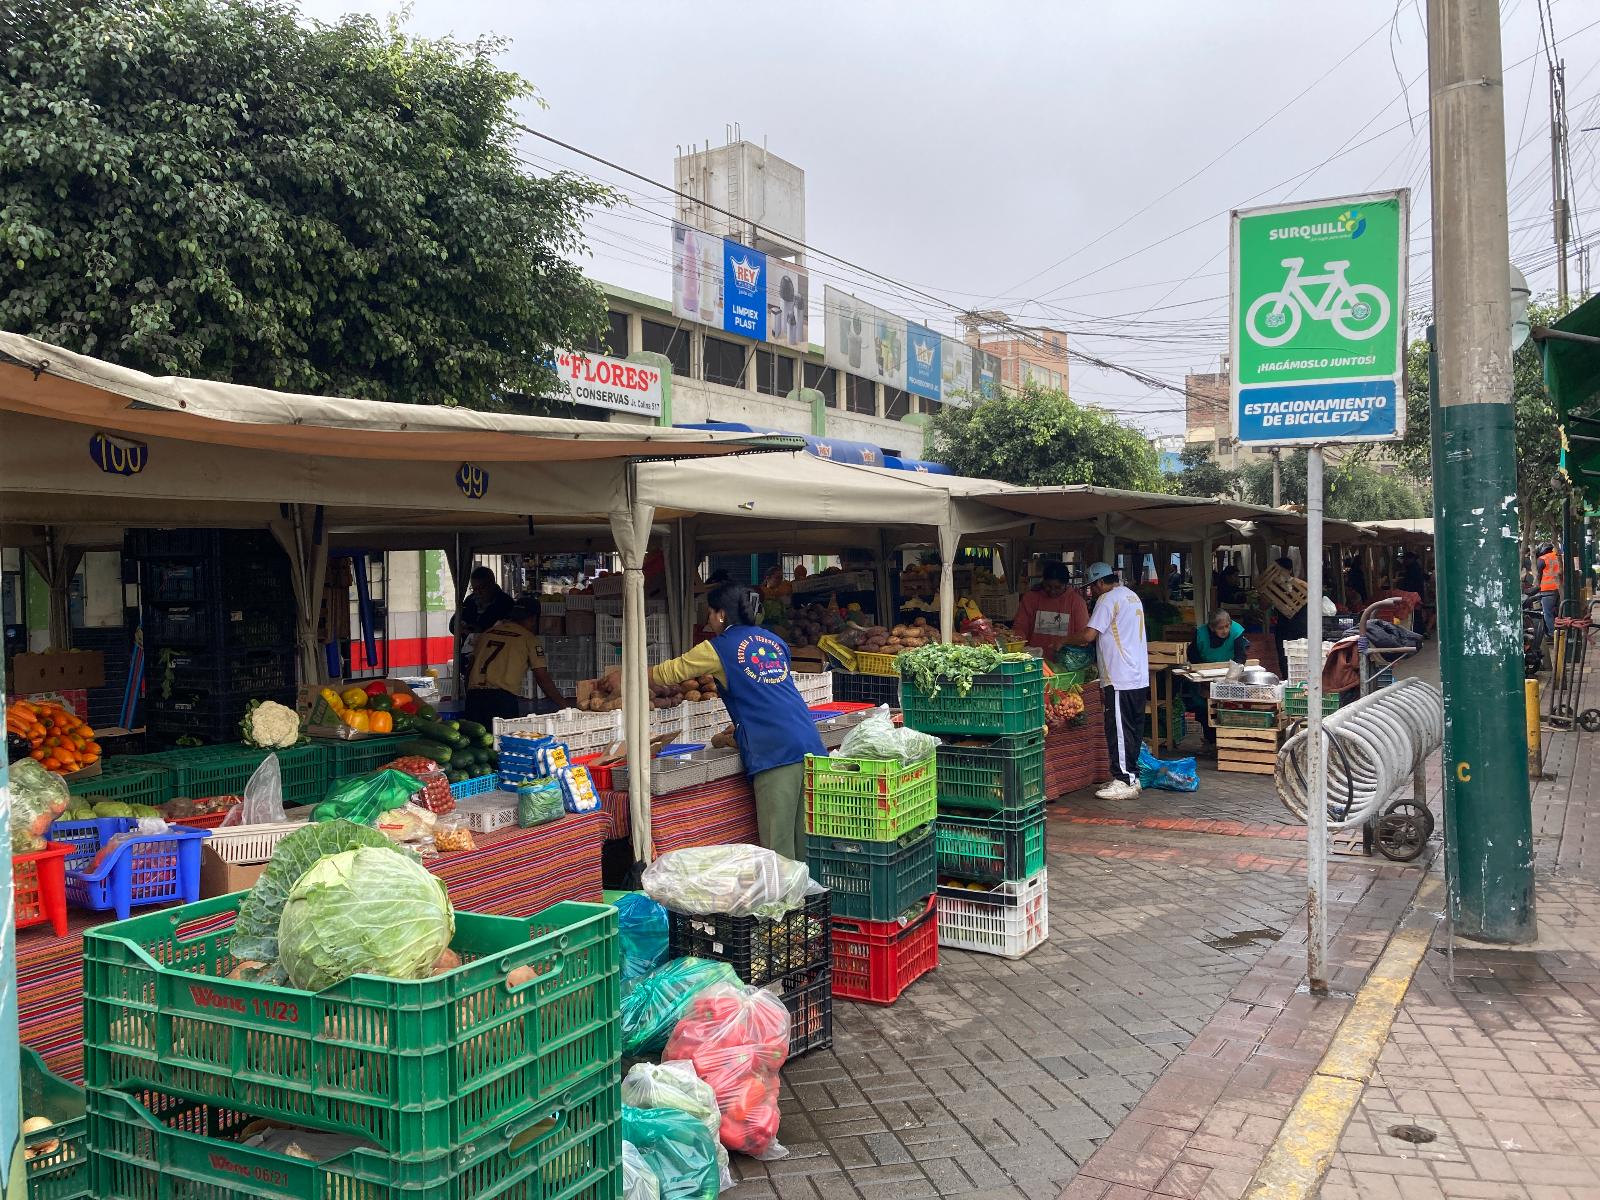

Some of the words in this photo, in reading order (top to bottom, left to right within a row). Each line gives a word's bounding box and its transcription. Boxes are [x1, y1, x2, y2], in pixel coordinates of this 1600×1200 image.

[737, 266, 756, 285] REY
[734, 317, 756, 331] PLAST
[1257, 358, 1328, 373] ¡HAGÁMOSLO
[1329, 355, 1376, 367] JUNTOS!
[576, 386, 630, 406] CONSERVAS
[1244, 396, 1387, 415] ESTACIONAMIENTO
[1262, 415, 1283, 427] DE
[1284, 410, 1370, 426] BICICLETAS
[461, 462, 483, 497] 99
[480, 640, 506, 674] 7
[1457, 761, 1471, 782] C
[252, 997, 299, 1023] 11/23
